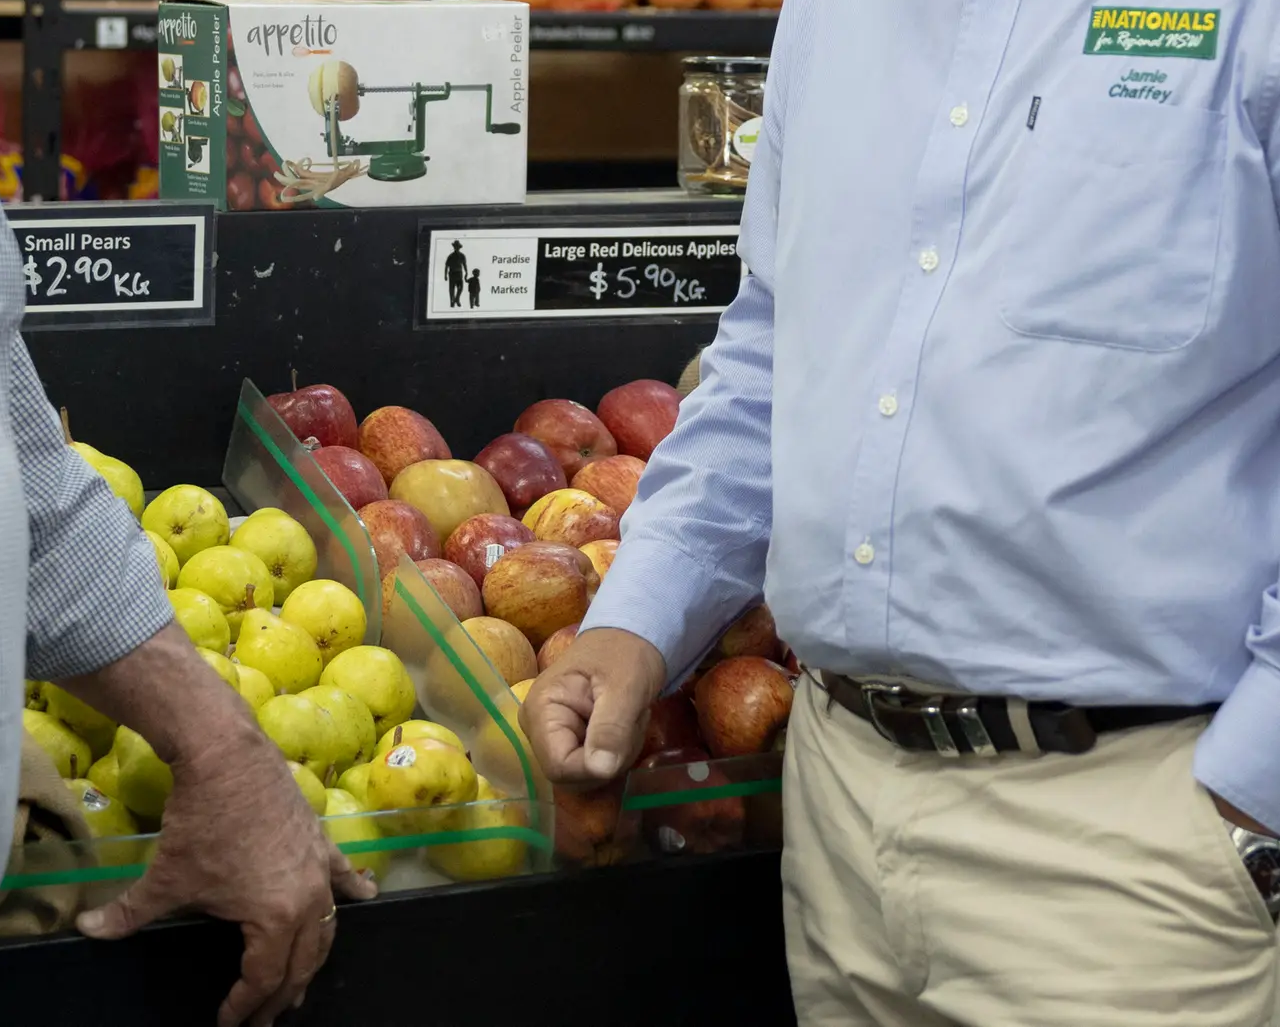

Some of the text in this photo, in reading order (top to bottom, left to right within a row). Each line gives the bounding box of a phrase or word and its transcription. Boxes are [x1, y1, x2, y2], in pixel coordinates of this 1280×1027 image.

[158, 12, 197, 45] appetito
[1101, 10, 1216, 31] NATIONALS
[247, 14, 338, 56] appetito
[212, 14, 223, 116] Apple Peeler
[510, 14, 526, 114] Apple Peeler
[1121, 69, 1168, 83] Jamie
[1108, 84, 1173, 104] Chaffey
[24, 233, 131, 251] Small Pears
[544, 241, 737, 260] Large Red Delicous Apples
[491, 254, 531, 264] Paradise
[498, 270, 522, 280] Farm
[491, 285, 529, 295] Markets
